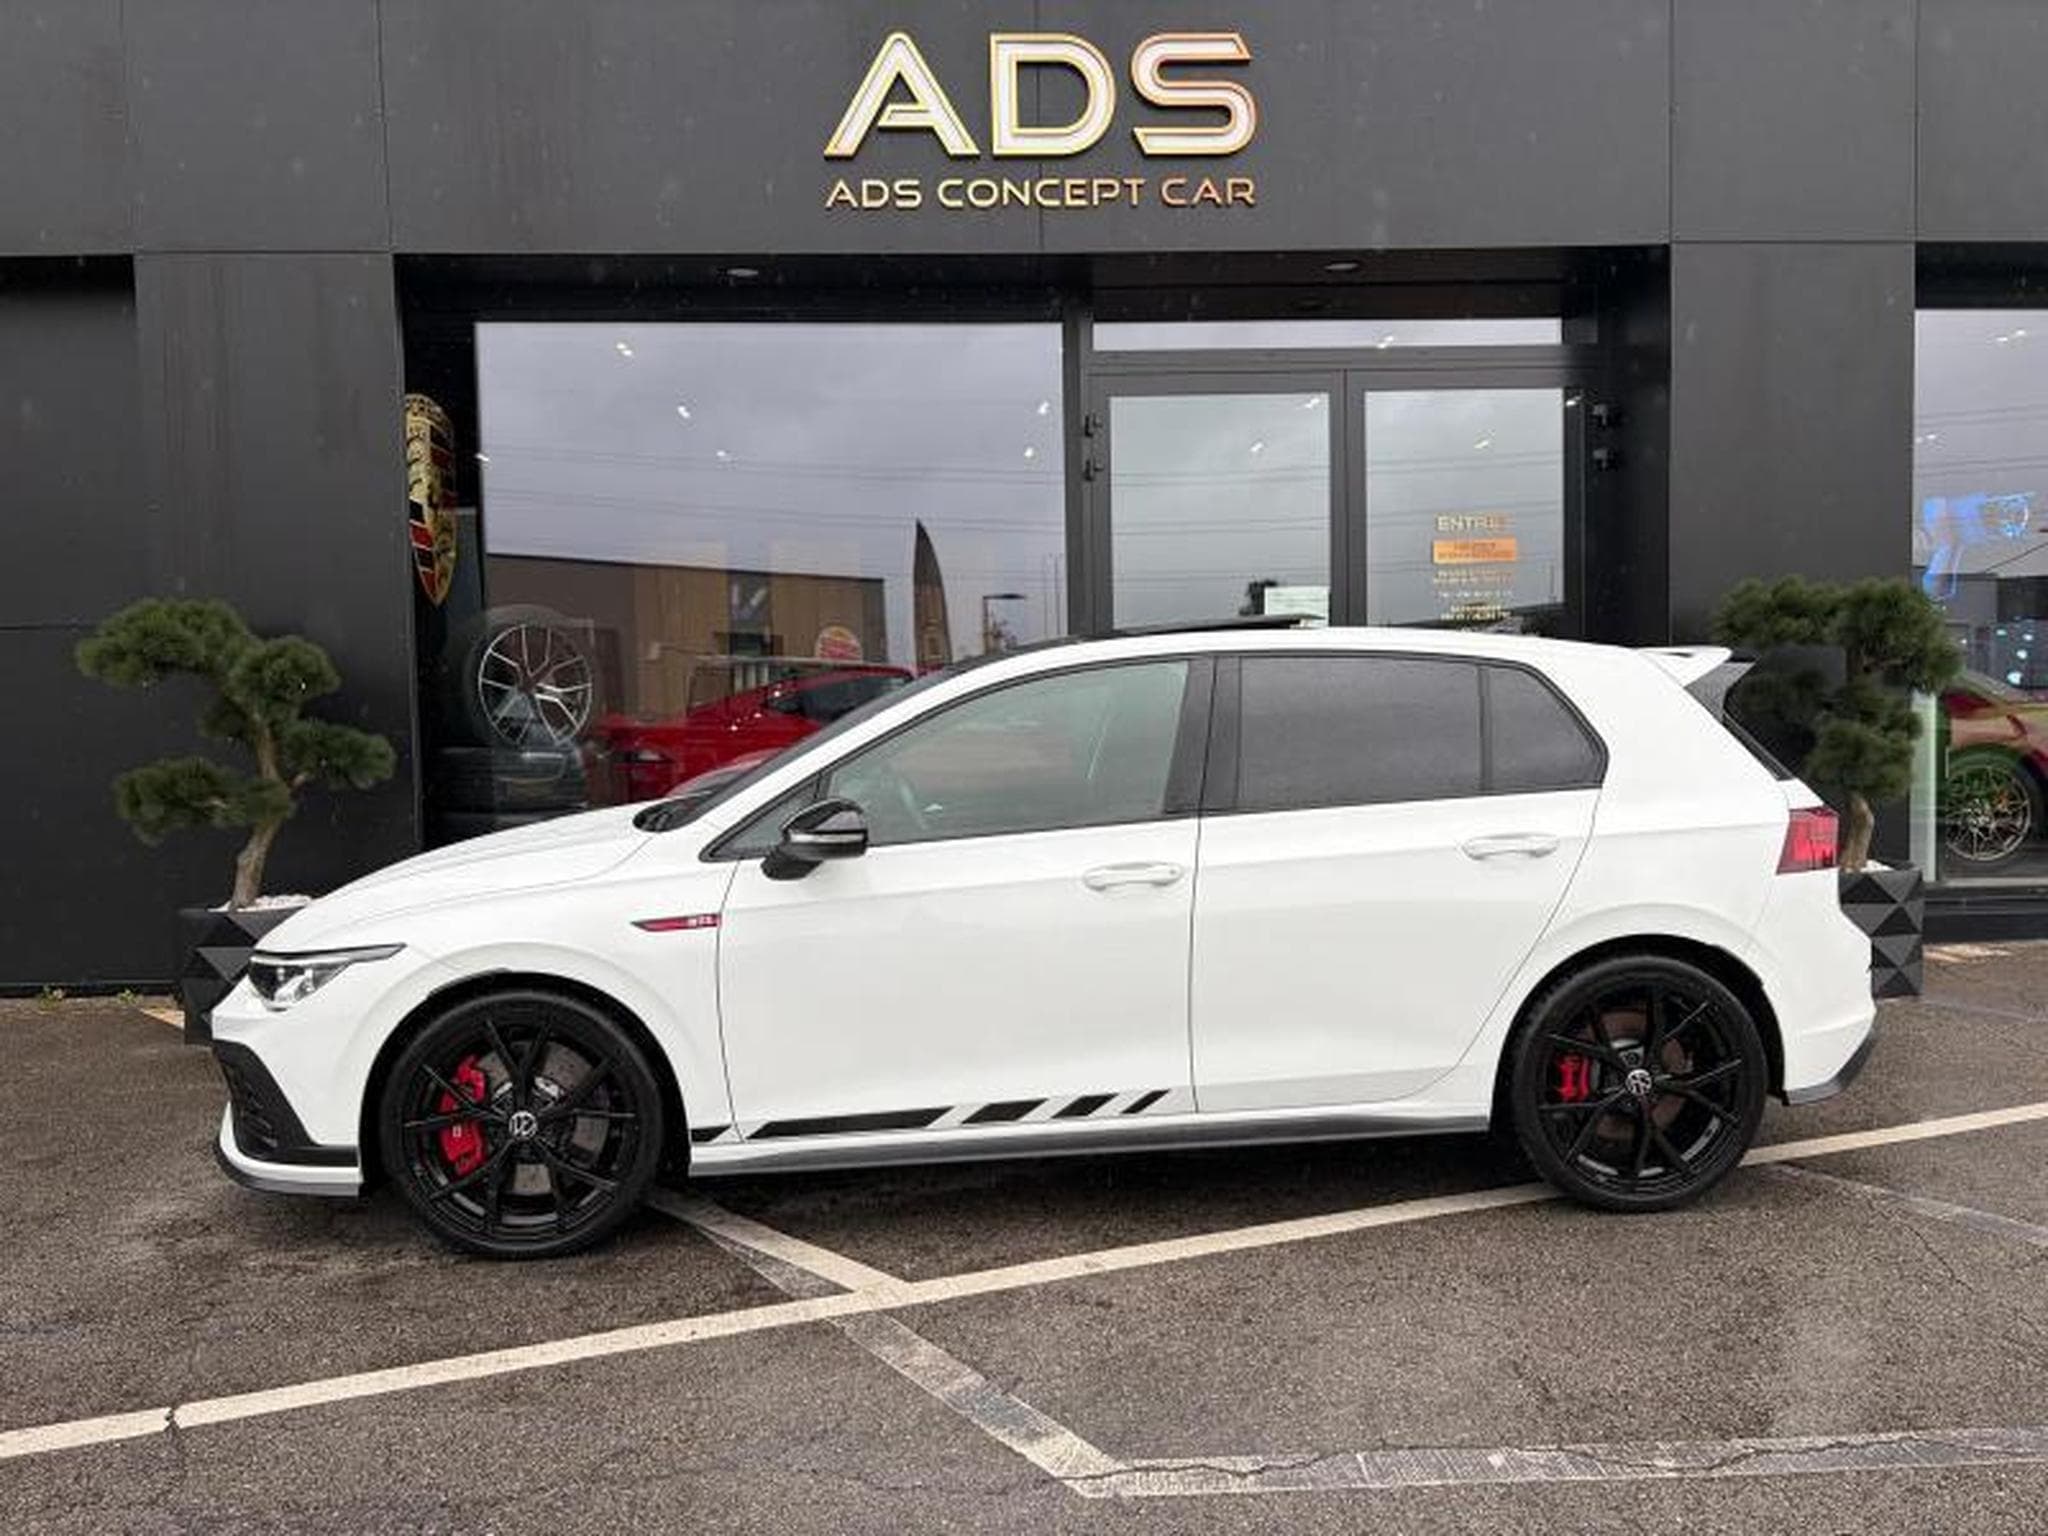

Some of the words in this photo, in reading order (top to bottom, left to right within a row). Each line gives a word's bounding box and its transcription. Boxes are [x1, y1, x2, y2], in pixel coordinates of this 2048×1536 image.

[824, 32, 1256, 156] ADS
[825, 179, 922, 208] ADS
[937, 178, 1146, 207] CONCEPT
[1160, 177, 1256, 206] CAR
